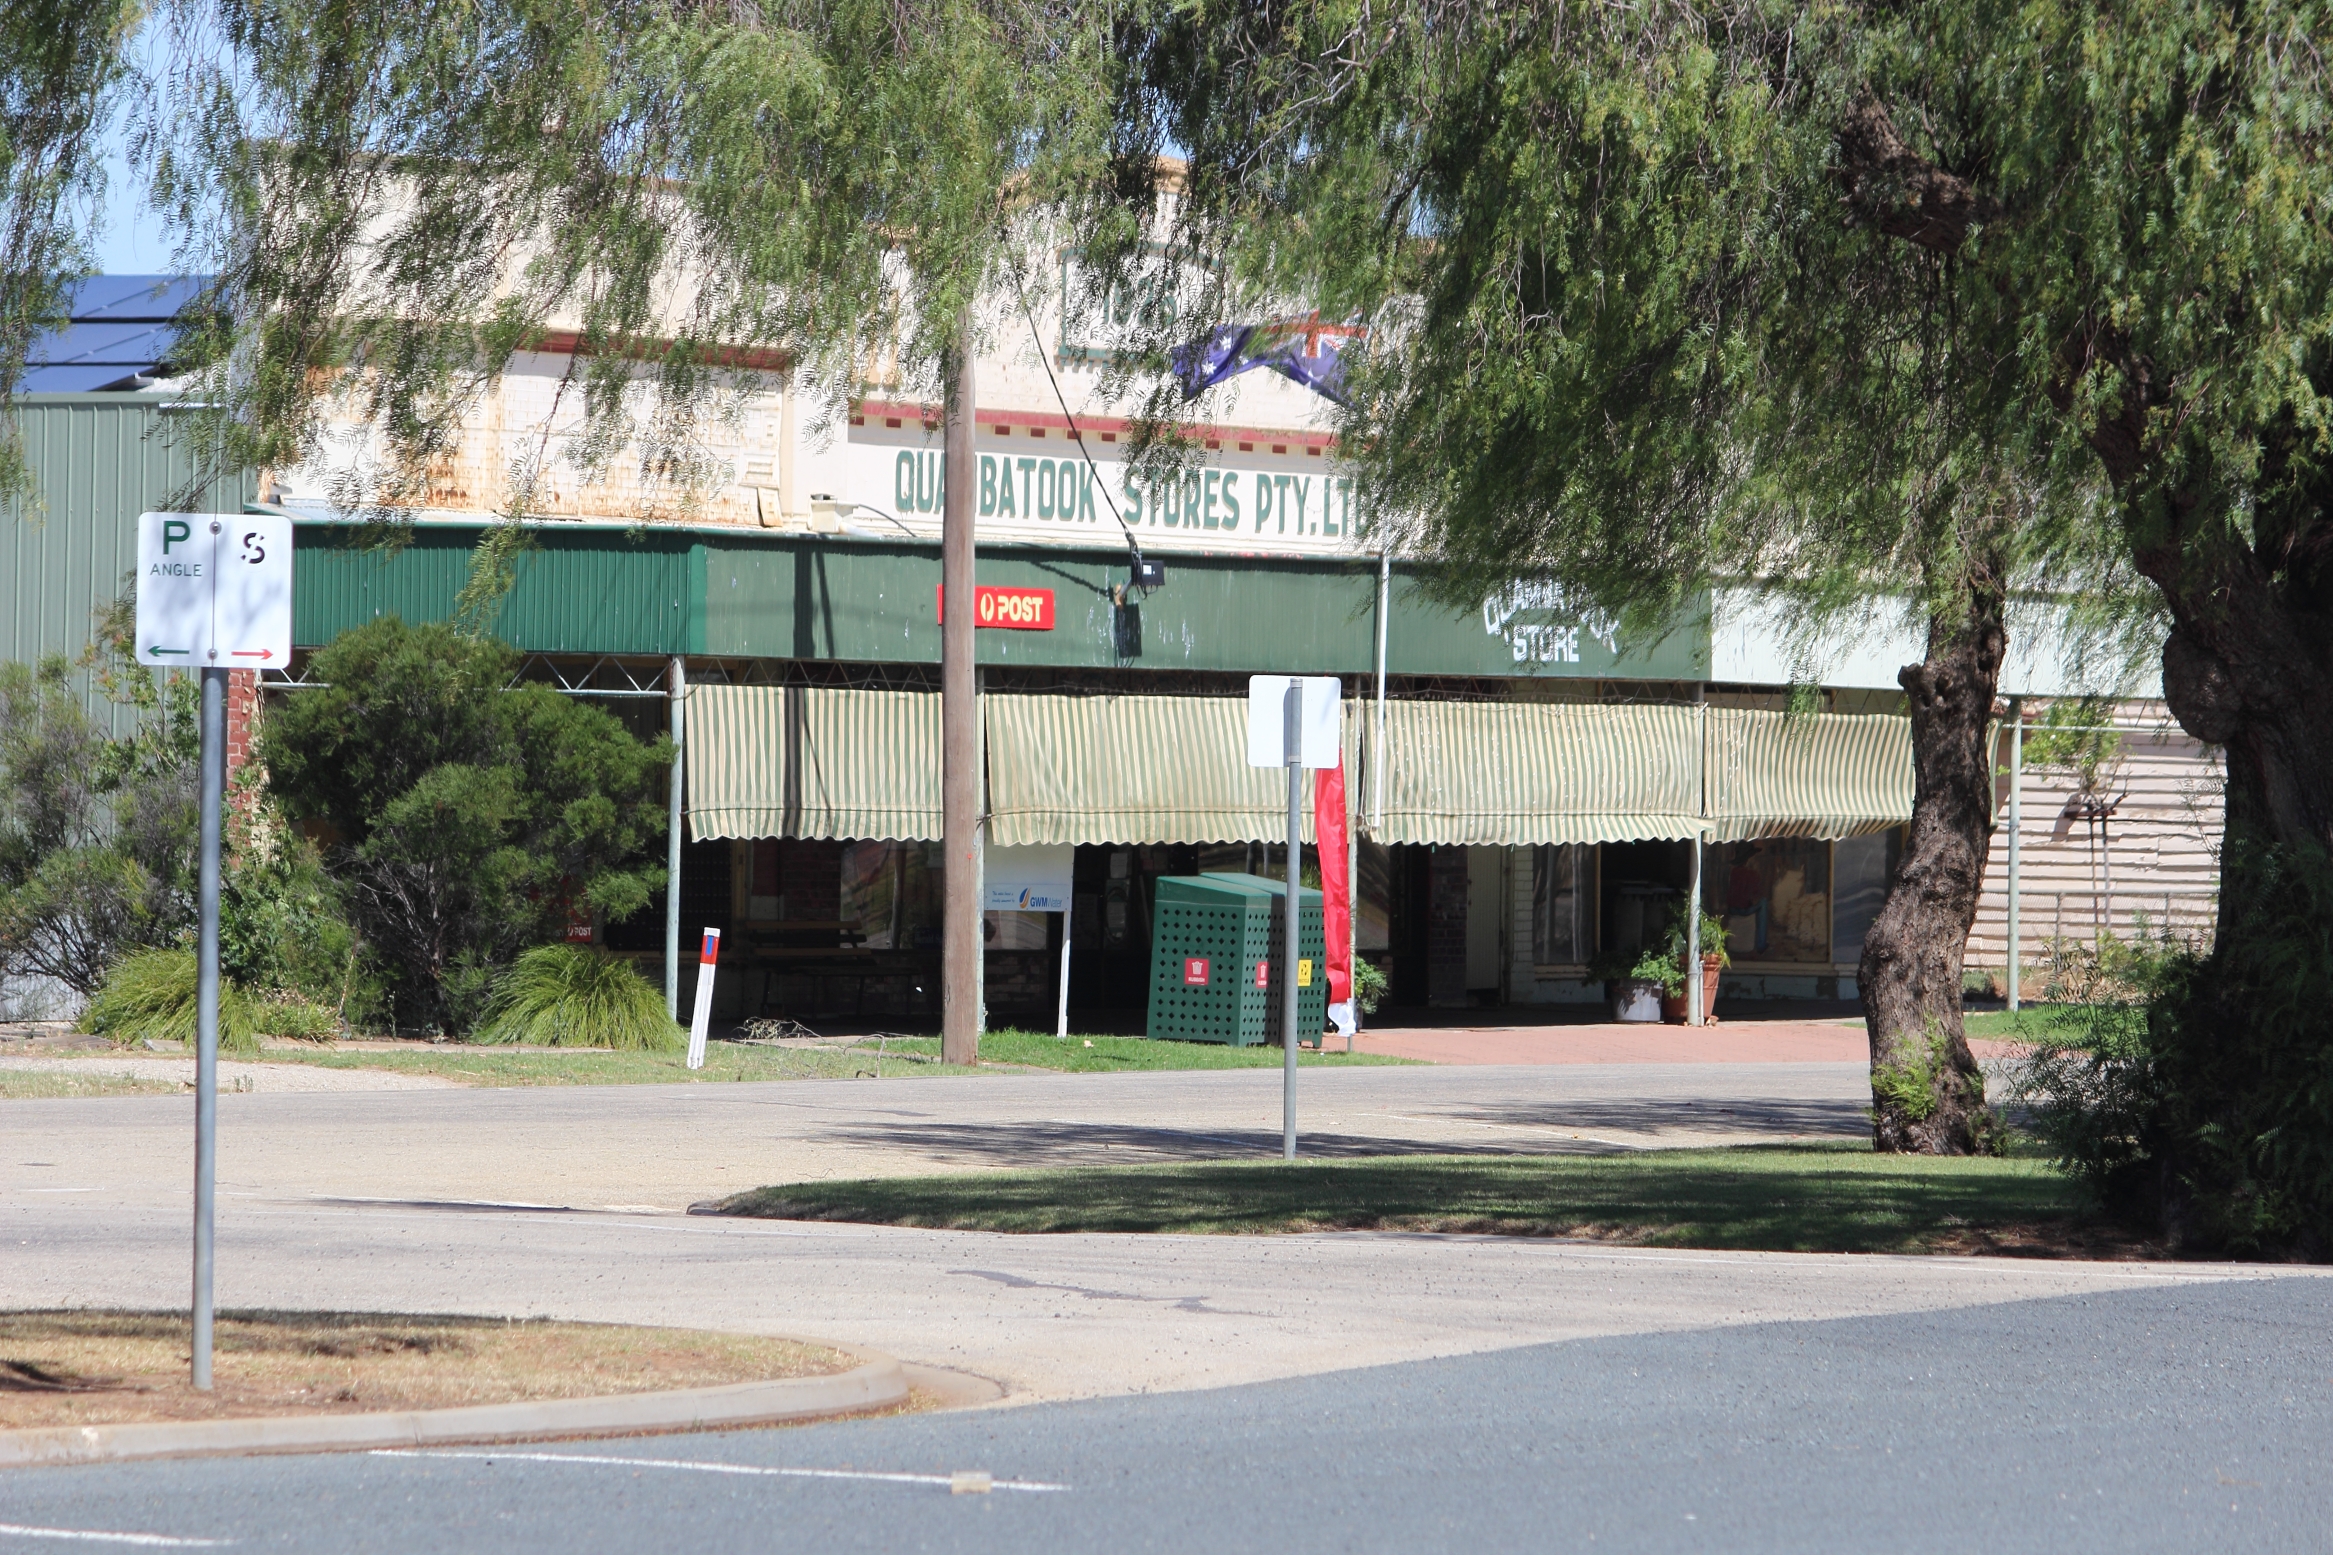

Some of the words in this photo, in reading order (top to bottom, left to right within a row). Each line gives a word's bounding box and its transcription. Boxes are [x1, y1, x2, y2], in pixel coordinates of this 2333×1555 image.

[895, 450, 1097, 522] QUABATOOK
[1123, 464, 1240, 530] STORES
[163, 521, 190, 555] P
[150, 563, 202, 577] ANGLE
[998, 595, 1043, 622] POST
[1513, 624, 1579, 662] STORE
